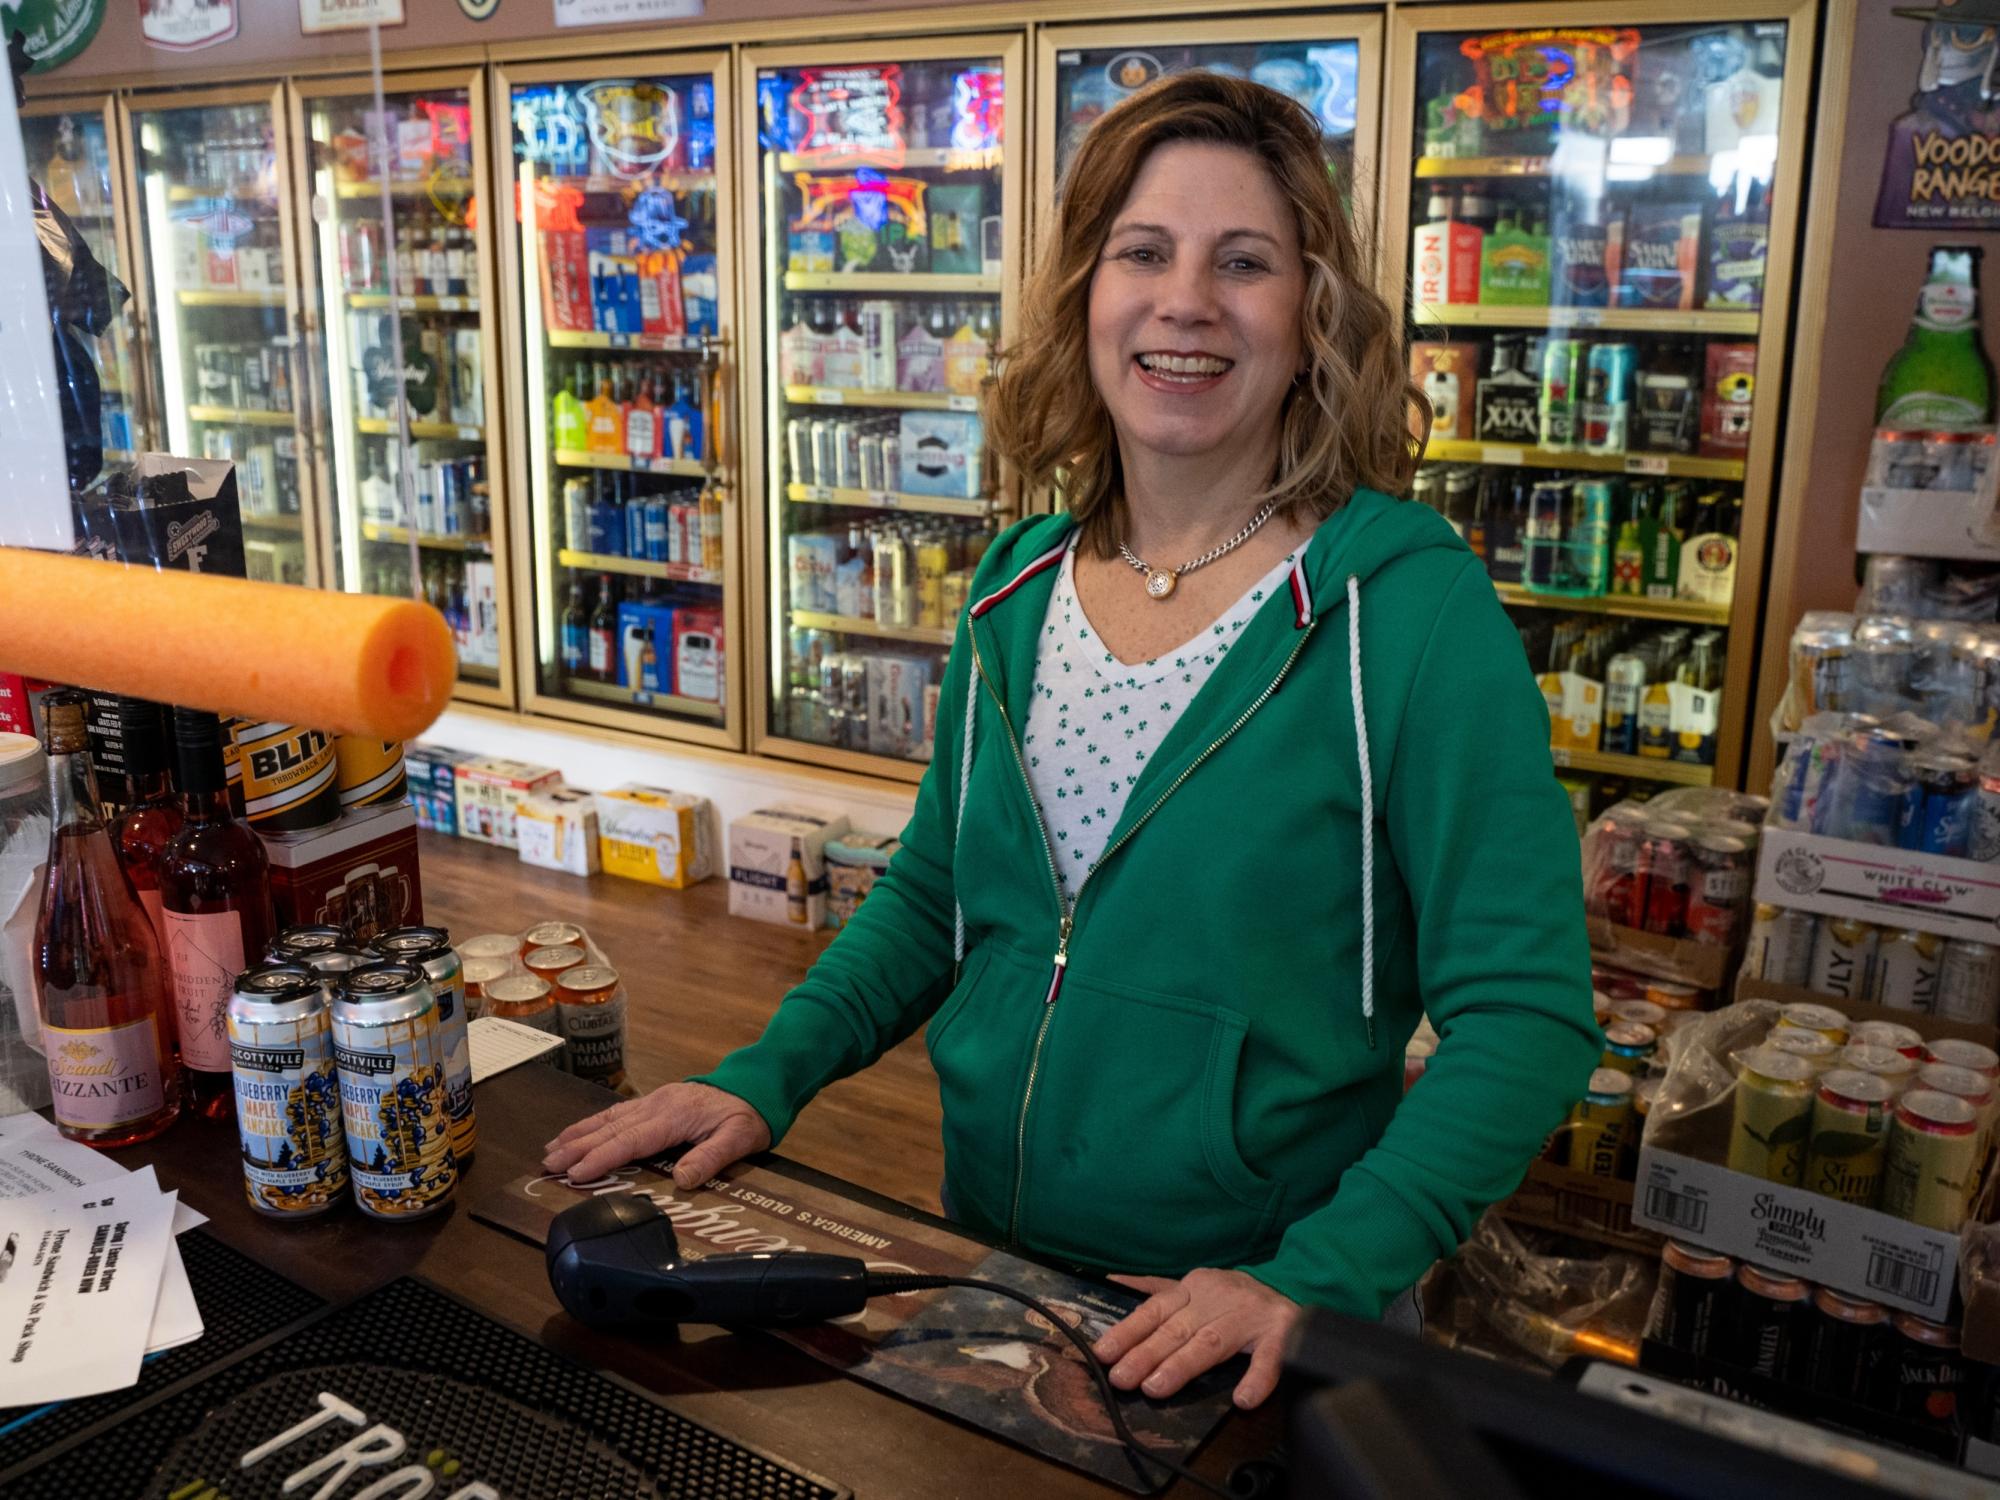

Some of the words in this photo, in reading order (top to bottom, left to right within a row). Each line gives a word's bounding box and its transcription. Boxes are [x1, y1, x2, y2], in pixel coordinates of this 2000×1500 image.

[1912, 132, 2000, 167] VOODO
[1911, 166, 2000, 202] RANGE
[1906, 205, 1945, 217] NEW
[1481, 404, 1539, 435] XXX
[271, 759, 319, 786] THROWBACK
[1863, 869, 1914, 888] WHITE
[1922, 878, 1970, 897] CLAW
[245, 1101, 277, 1119] MAPLE
[44, 1161, 87, 1188] SANDWICH
[650, 1160, 729, 1193] BRRY
[728, 1188, 794, 1216] OLDEST
[1750, 1192, 1826, 1240] Simply
[49, 1229, 71, 1254] Tyrone
[110, 1220, 130, 1244] Spring
[796, 1210, 892, 1250] AMERICA'S
[104, 1247, 123, 1268] Easter
[37, 1255, 62, 1292] Sandwich
[98, 1268, 117, 1293] Orders
[29, 1302, 45, 1315] Six
[21, 1316, 41, 1339] Pack
[10, 1340, 33, 1364] Shop
